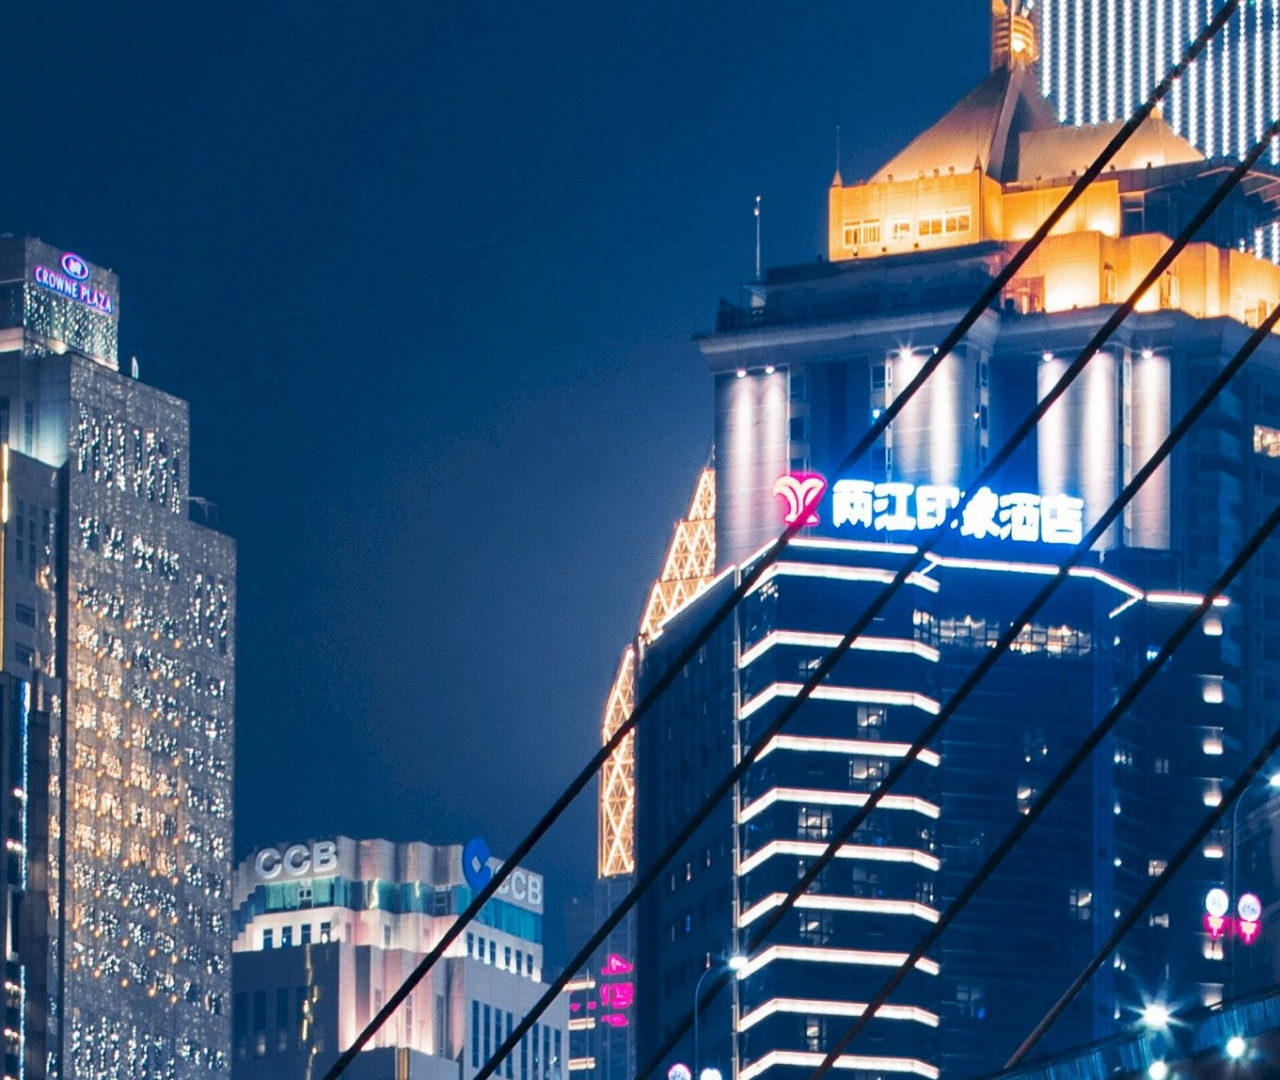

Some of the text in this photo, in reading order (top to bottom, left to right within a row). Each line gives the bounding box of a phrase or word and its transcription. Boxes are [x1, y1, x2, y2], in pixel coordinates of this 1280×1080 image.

[34, 265, 113, 314] CROWNE PLAZA
[254, 840, 338, 879] CCB
